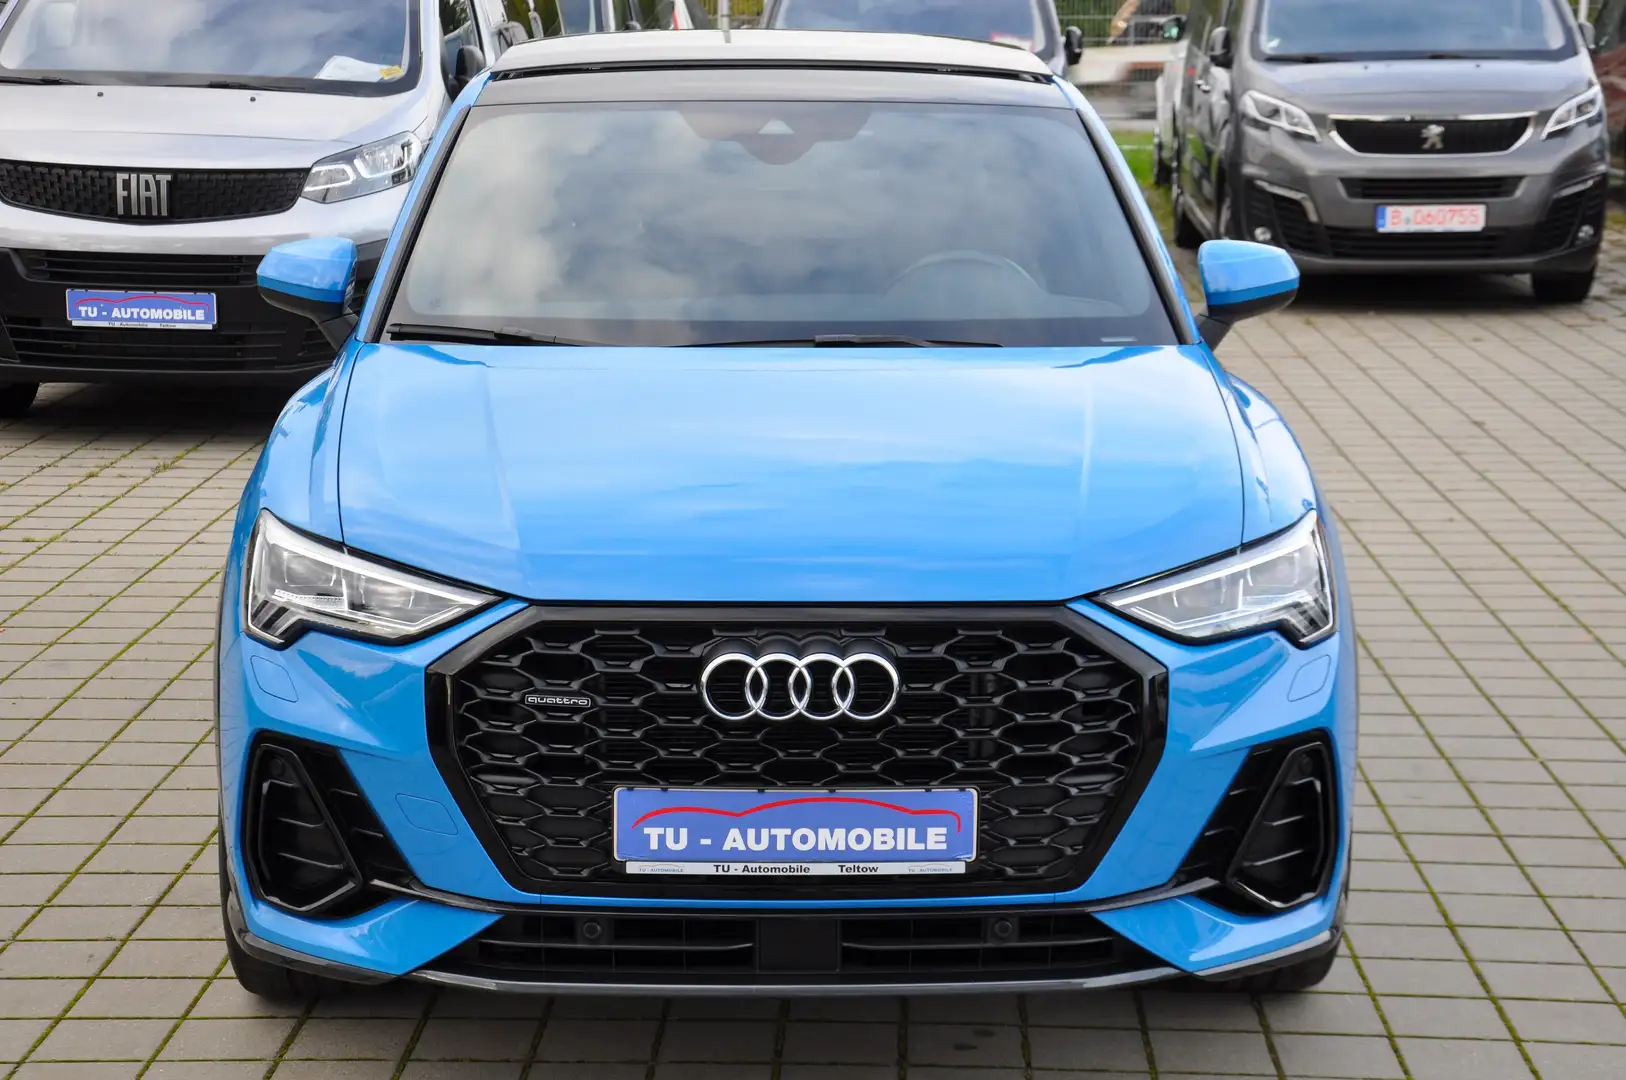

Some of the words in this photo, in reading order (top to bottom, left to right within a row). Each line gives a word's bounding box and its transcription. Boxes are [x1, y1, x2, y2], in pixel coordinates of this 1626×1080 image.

[116, 173, 171, 216] FIAT
[1390, 209, 1402, 226] B
[79, 306, 98, 318] TU
[111, 307, 205, 321] AUTOMOBILE
[527, 696, 588, 705] quattro
[643, 827, 688, 851] TU
[722, 827, 948, 851] AUTOMOBILE
[713, 864, 730, 873] TU
[742, 864, 811, 873] Automobile
[837, 864, 879, 873] Teltow
